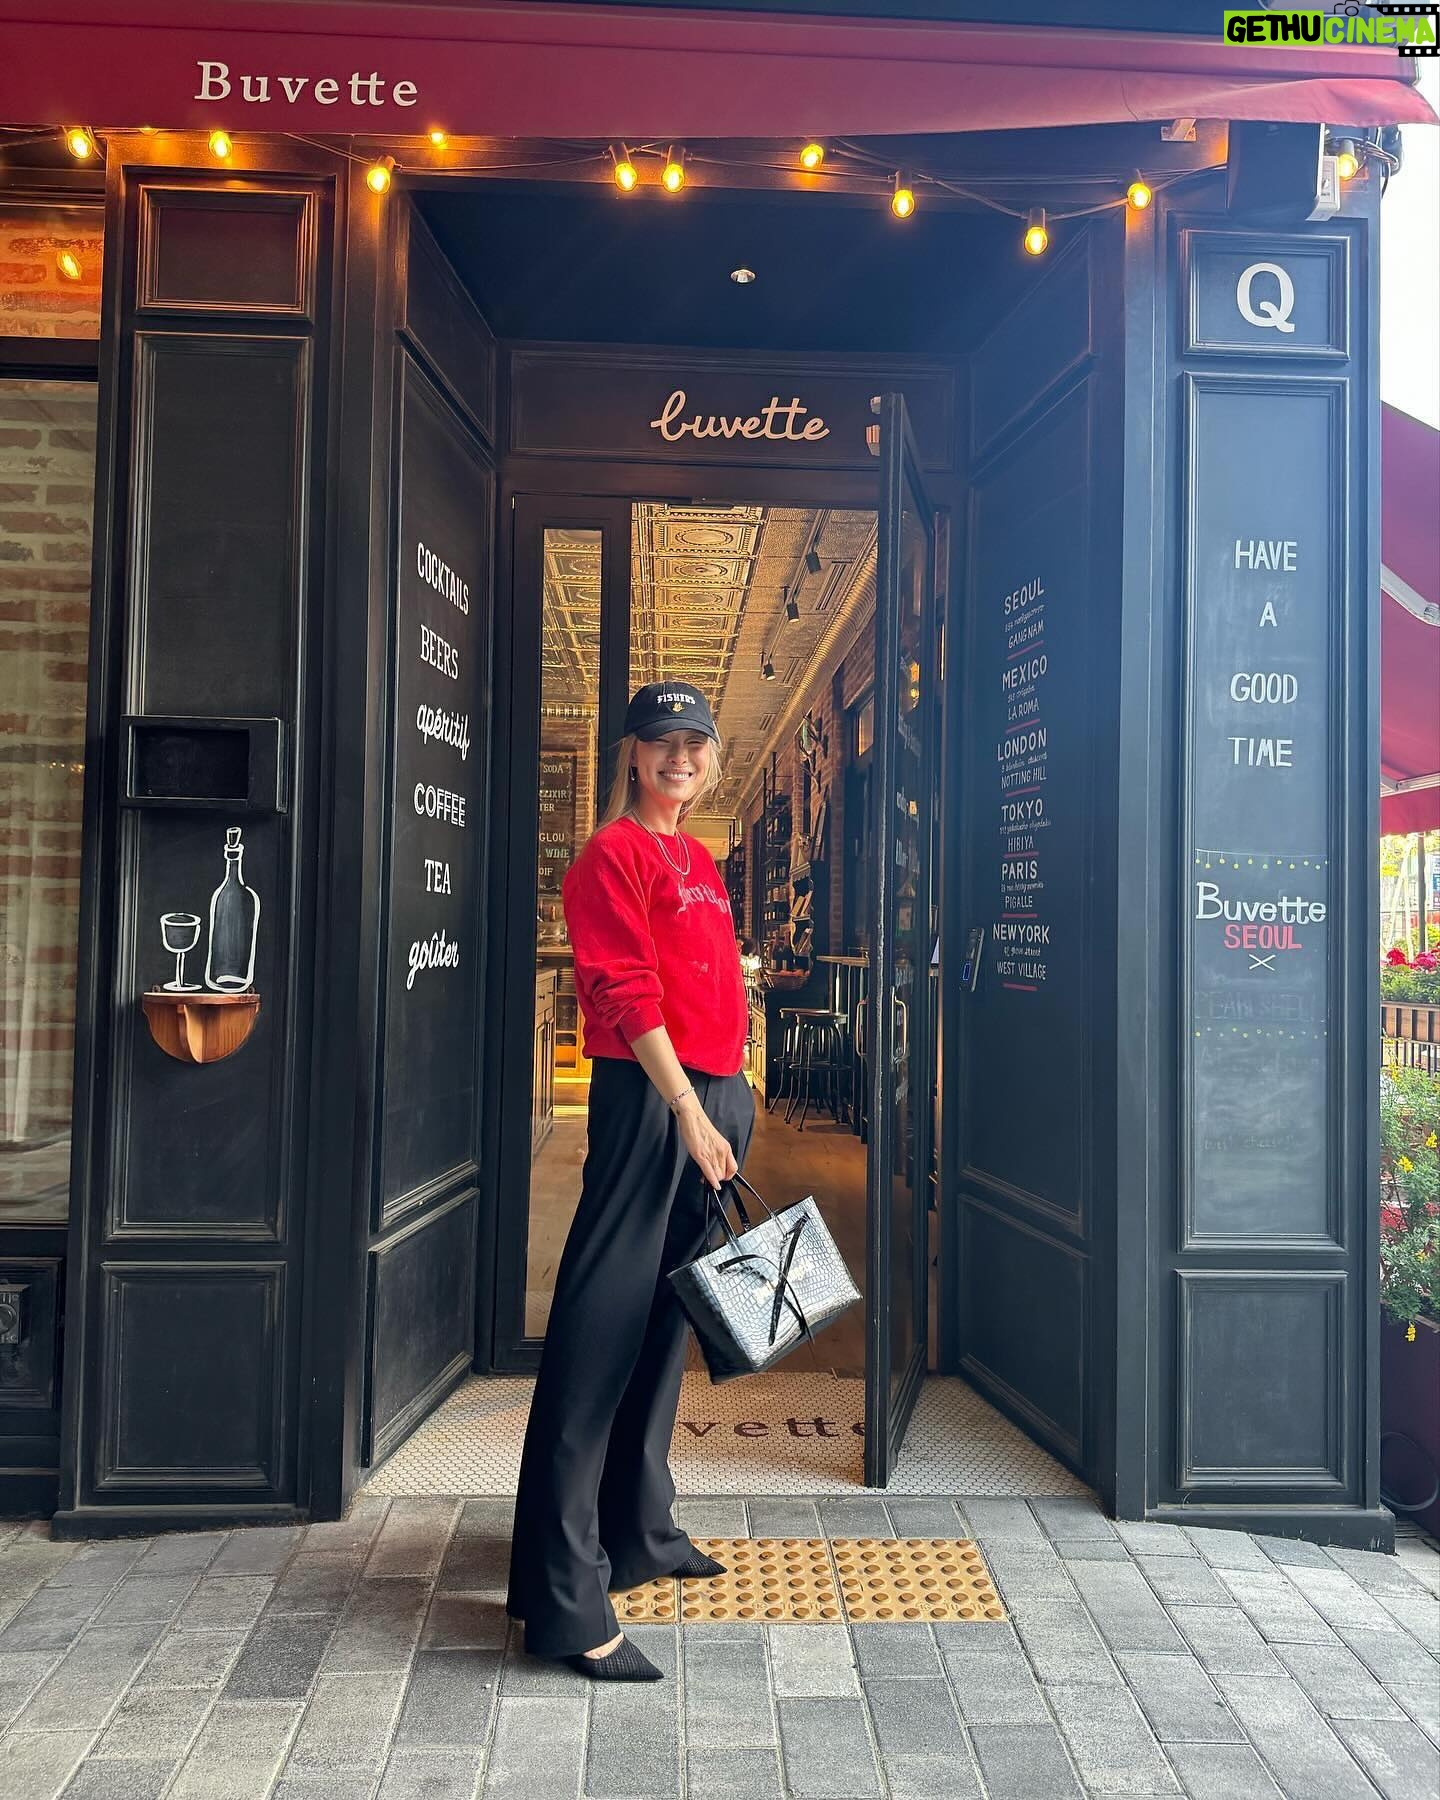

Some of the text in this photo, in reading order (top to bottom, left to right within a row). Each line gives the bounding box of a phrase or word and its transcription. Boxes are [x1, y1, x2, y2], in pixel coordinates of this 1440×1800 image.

[194, 61, 418, 106] Buvette
[1236, 262, 1295, 333] Q
[650, 390, 830, 441] buvette
[1235, 540, 1297, 571] HAVE
[417, 542, 469, 616] COCKTAILS
[1004, 577, 1044, 615] SEOUL
[1259, 602, 1277, 627] A
[1008, 620, 1044, 649] GANGNAM
[420, 624, 459, 680] BEERS
[1002, 655, 1047, 691] MEXICO
[1230, 673, 1298, 704] GOOD
[1018, 698, 1040, 717] ROMA
[416, 704, 470, 760] apéritif
[997, 727, 1047, 761] LONDON
[1228, 737, 1293, 766] TIME
[1001, 765, 1047, 790] NOTTING HILL
[413, 782, 466, 828] COFFEE
[1001, 798, 1043, 822] TOKYO
[1008, 835, 1034, 852] HIBIYA
[424, 858, 451, 895] TEA
[1002, 860, 1038, 880] PARIS
[1005, 895, 1033, 909] PIGALLE
[1195, 881, 1327, 925] Buvette
[1224, 924, 1303, 949] SEOUL
[407, 929, 460, 991] goûter
[997, 961, 1047, 980] WEST VILLAGE
